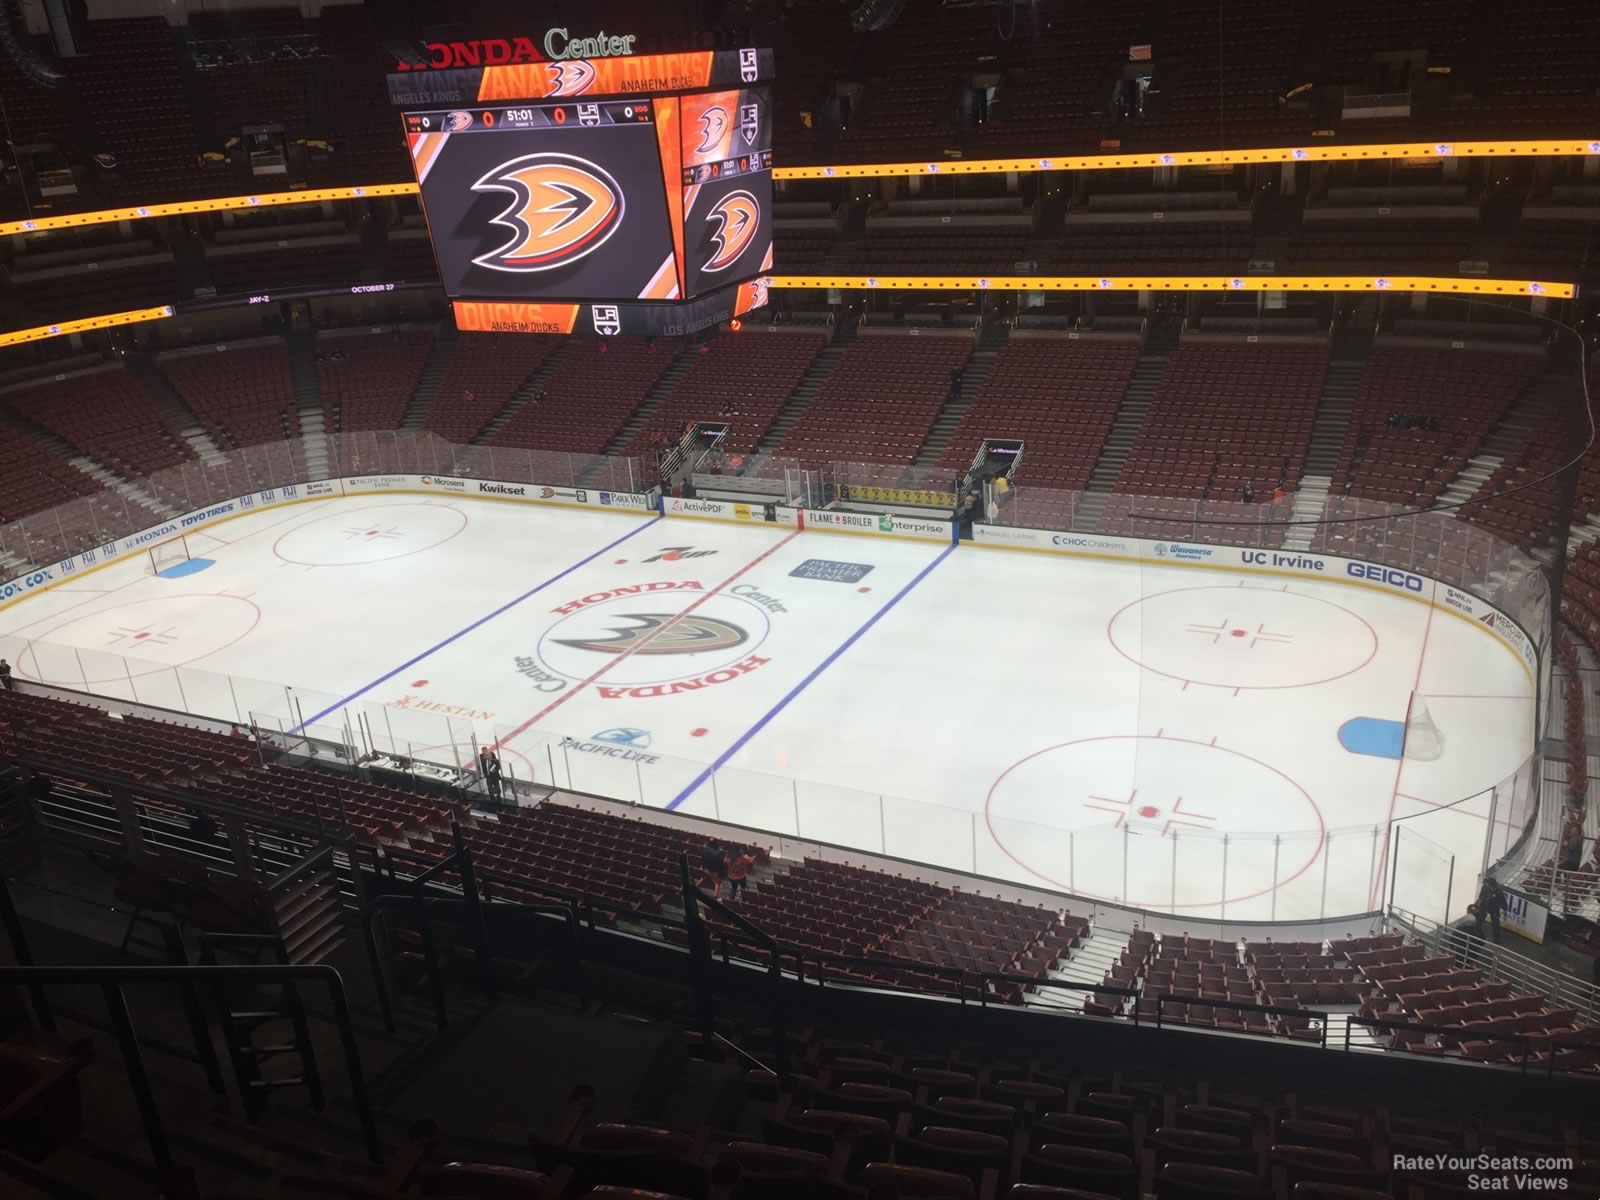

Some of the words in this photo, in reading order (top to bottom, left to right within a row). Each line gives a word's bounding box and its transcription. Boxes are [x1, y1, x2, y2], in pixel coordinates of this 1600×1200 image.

[397, 37, 544, 70] ONDA
[544, 27, 636, 60] Center
[621, 79, 668, 92] ANAHEIM
[671, 76, 693, 88] DUCKS
[392, 93, 431, 105] ANGELES
[434, 91, 461, 102] KINGS
[507, 109, 533, 121] 51:01
[554, 107, 566, 125] 0
[624, 106, 633, 118] 0
[422, 117, 430, 128] 0
[482, 111, 495, 128] 0
[712, 165, 719, 176] 0
[741, 159, 747, 171] 0
[352, 285, 385, 293] OCTOBER
[249, 296, 270, 304] JAY-Z
[491, 321, 528, 331] ANAHEIM
[532, 323, 559, 332] DUCKS
[664, 325, 683, 336] LOS
[434, 478, 464, 487] Microsemi
[479, 482, 525, 496] Kwikset
[261, 491, 274, 502] FIJI
[285, 486, 297, 497] FIJI
[240, 496, 253, 508] FIJI
[684, 502, 722, 513] ActivePDF
[181, 511, 205, 527] TOYO
[207, 504, 233, 518] TIRES
[810, 514, 833, 524] FLAME
[842, 516, 872, 527] BROILER
[884, 519, 943, 533] enterprise
[135, 524, 177, 545] HONDA
[1062, 537, 1087, 546] CHOC
[102, 543, 117, 557] FIJI
[1170, 544, 1212, 556] Wawanesa
[81, 550, 96, 565] FIJI
[1242, 551, 1267, 565] UC
[1272, 554, 1324, 570] Irvine
[60, 559, 75, 573] FIJI
[799, 564, 862, 577] PREMIER
[808, 560, 863, 570] PACIFIC
[26, 571, 54, 588] COX
[804, 571, 843, 581] BANK
[1347, 562, 1423, 592] GEICO
[550, 581, 704, 615] HONDA
[730, 584, 787, 613] Center
[1496, 612, 1525, 641] MERCURY
[514, 655, 567, 693] Center
[596, 655, 772, 699] HONDA
[415, 700, 496, 721] HESTAN
[557, 737, 622, 757] PACIFIC
[622, 751, 660, 765] LIFE
